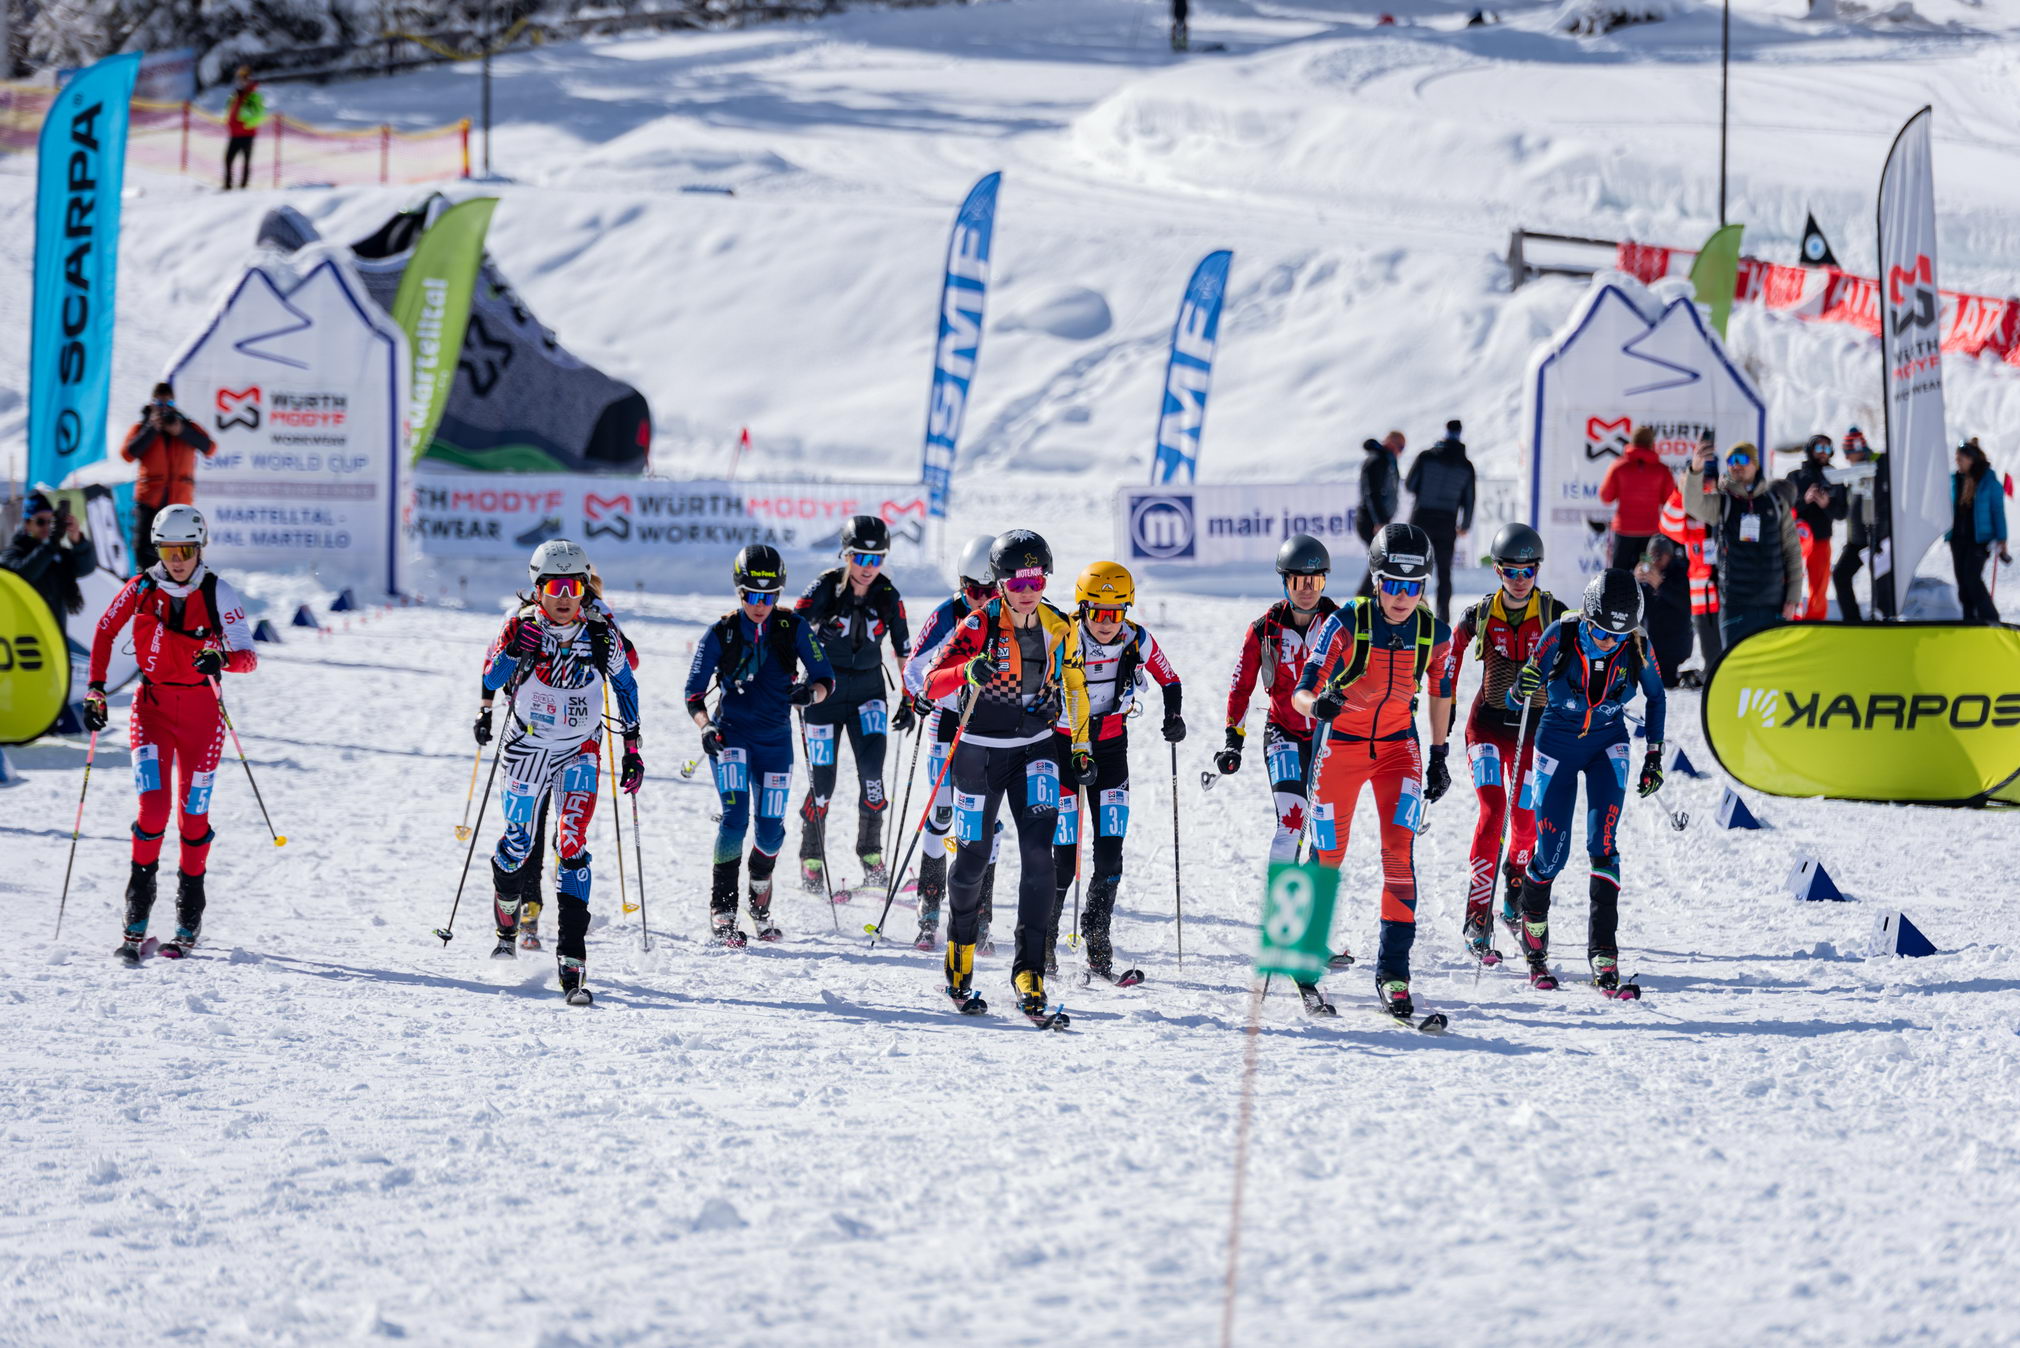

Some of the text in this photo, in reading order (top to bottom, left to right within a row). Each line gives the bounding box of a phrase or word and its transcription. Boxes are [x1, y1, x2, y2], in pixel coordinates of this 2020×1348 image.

[60, 101, 103, 386] SCARPA
[270, 392, 347, 410] WÜRTH
[1153, 299, 1215, 486] MF
[270, 411, 347, 428] MODYF
[203, 455, 369, 473] SMF WORLD CUP
[452, 489, 563, 513] MODYF
[1563, 482, 1599, 499] ISM
[215, 507, 334, 526] MARTELLTAL
[637, 492, 859, 519] WÜRTH MODYF
[415, 518, 501, 540] KWEAR
[636, 522, 797, 547] WORKWEAR
[1209, 508, 1274, 536] mair
[210, 531, 351, 549] VAL MARTELLO
[1781, 692, 2020, 731] KARPOS
[572, 766, 589, 790] 7.1
[722, 763, 743, 790] 10.1
[1037, 775, 1053, 803] 6.1
[507, 795, 523, 821] 7.1
[561, 791, 591, 849] KAR
[1108, 806, 1124, 836] 3.1
[1405, 799, 1419, 832] 4.1
[956, 810, 971, 839] 6.1
[1057, 814, 1074, 844] 3.1
[1603, 804, 1620, 857] ARPOS
